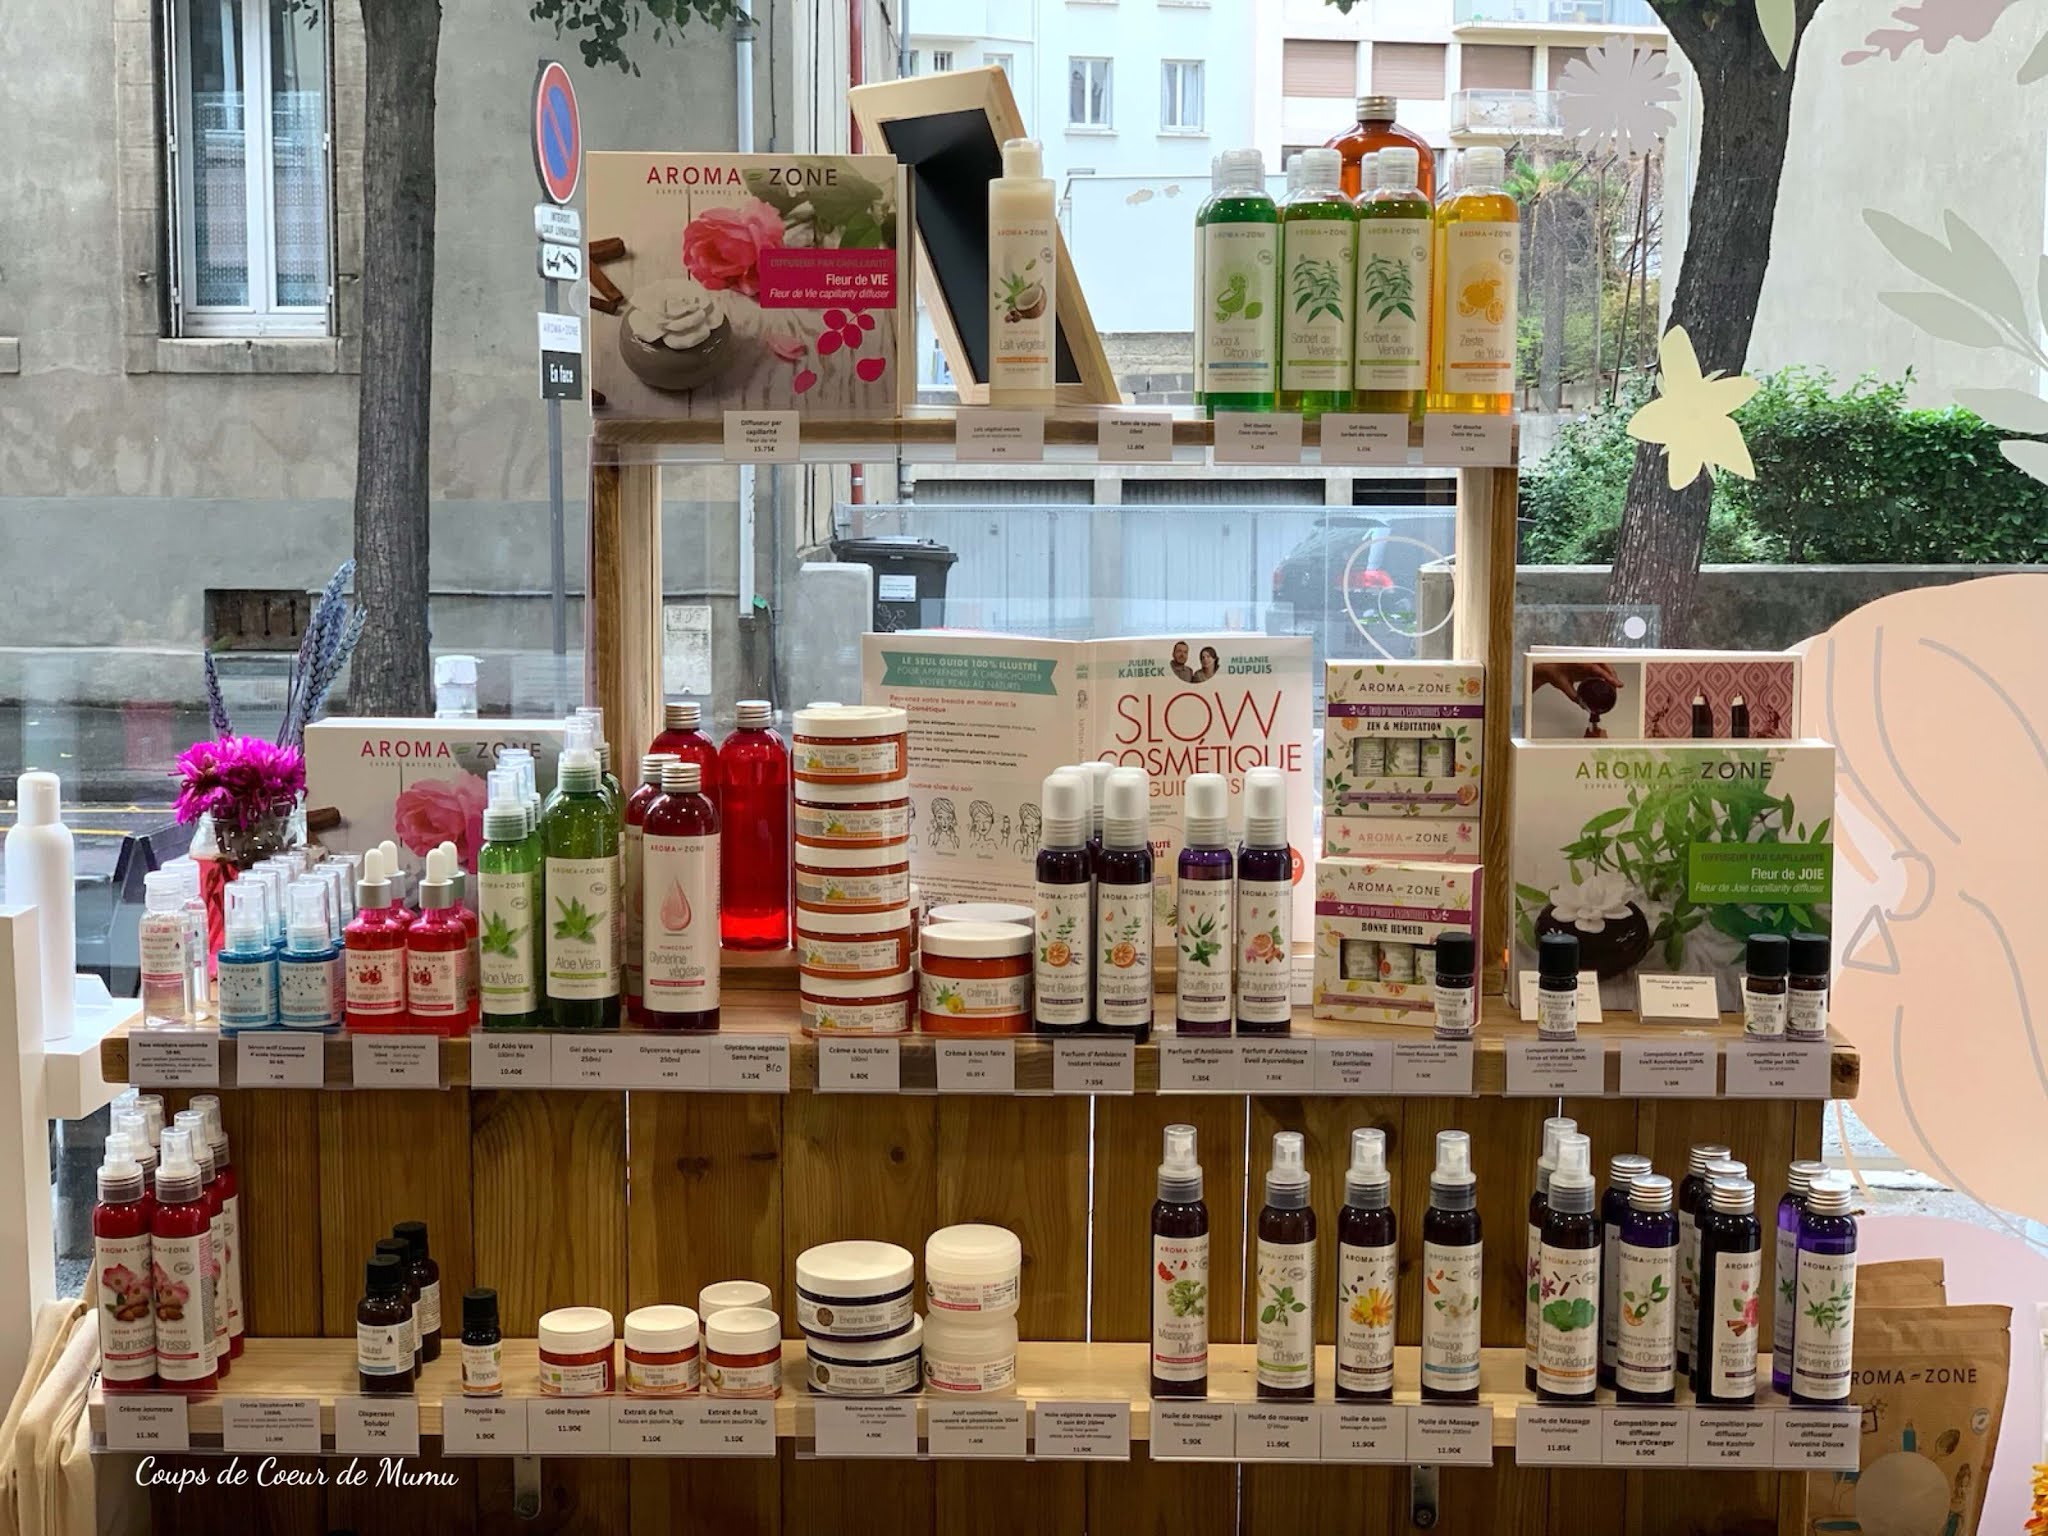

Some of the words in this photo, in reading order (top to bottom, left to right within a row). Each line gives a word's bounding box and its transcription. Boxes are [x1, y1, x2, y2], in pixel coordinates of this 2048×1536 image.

[647, 167, 741, 185] AROMA
[769, 168, 838, 186] ZONE
[826, 274, 851, 285] Fleur
[855, 274, 868, 285] de
[871, 274, 888, 285] VIE
[770, 288, 789, 298] Fleur
[792, 288, 804, 298] de
[805, 288, 818, 298] Vie
[560, 364, 574, 383] face
[902, 656, 912, 664] LE
[915, 657, 936, 665] SEUL
[940, 658, 968, 667] GUIDE
[1000, 660, 1038, 670] ILLUSTRÉ
[1128, 659, 1155, 667] JULIEN
[1118, 667, 1165, 678] KAIBECK
[1228, 665, 1272, 674] DUPUIS
[1359, 683, 1404, 692] AROMA
[1418, 684, 1451, 693] ZONE
[907, 704, 946, 713] Cosmétique
[1116, 690, 1282, 744] SLOW
[1367, 722, 1380, 731] ZEN
[1383, 722, 1390, 731] &
[1393, 720, 1441, 731] MÉDITATION
[361, 741, 451, 757] AROMA
[1576, 762, 1672, 779] AROMA
[1701, 761, 1773, 779] ZONE
[1358, 833, 1403, 842] AROMA
[1416, 834, 1448, 842] ZONE
[1752, 868, 1778, 880] Fleur
[1782, 868, 1795, 880] de
[1798, 868, 1824, 880] JOIE
[1348, 882, 1393, 893] AROMA
[1407, 885, 1440, 896] ZONE
[1362, 923, 1387, 933] BONNE
[1391, 925, 1423, 935] HUMEUR
[556, 957, 576, 970] Aloe
[579, 957, 601, 969] Vera
[502, 971, 523, 984] Vera
[1721, 1353, 1744, 1367] Rose
[1851, 1370, 1905, 1385] ROMA
[1925, 1368, 1977, 1383] ZONE
[1614, 1419, 1658, 1427] Composition
[1700, 1420, 1744, 1428] Composition
